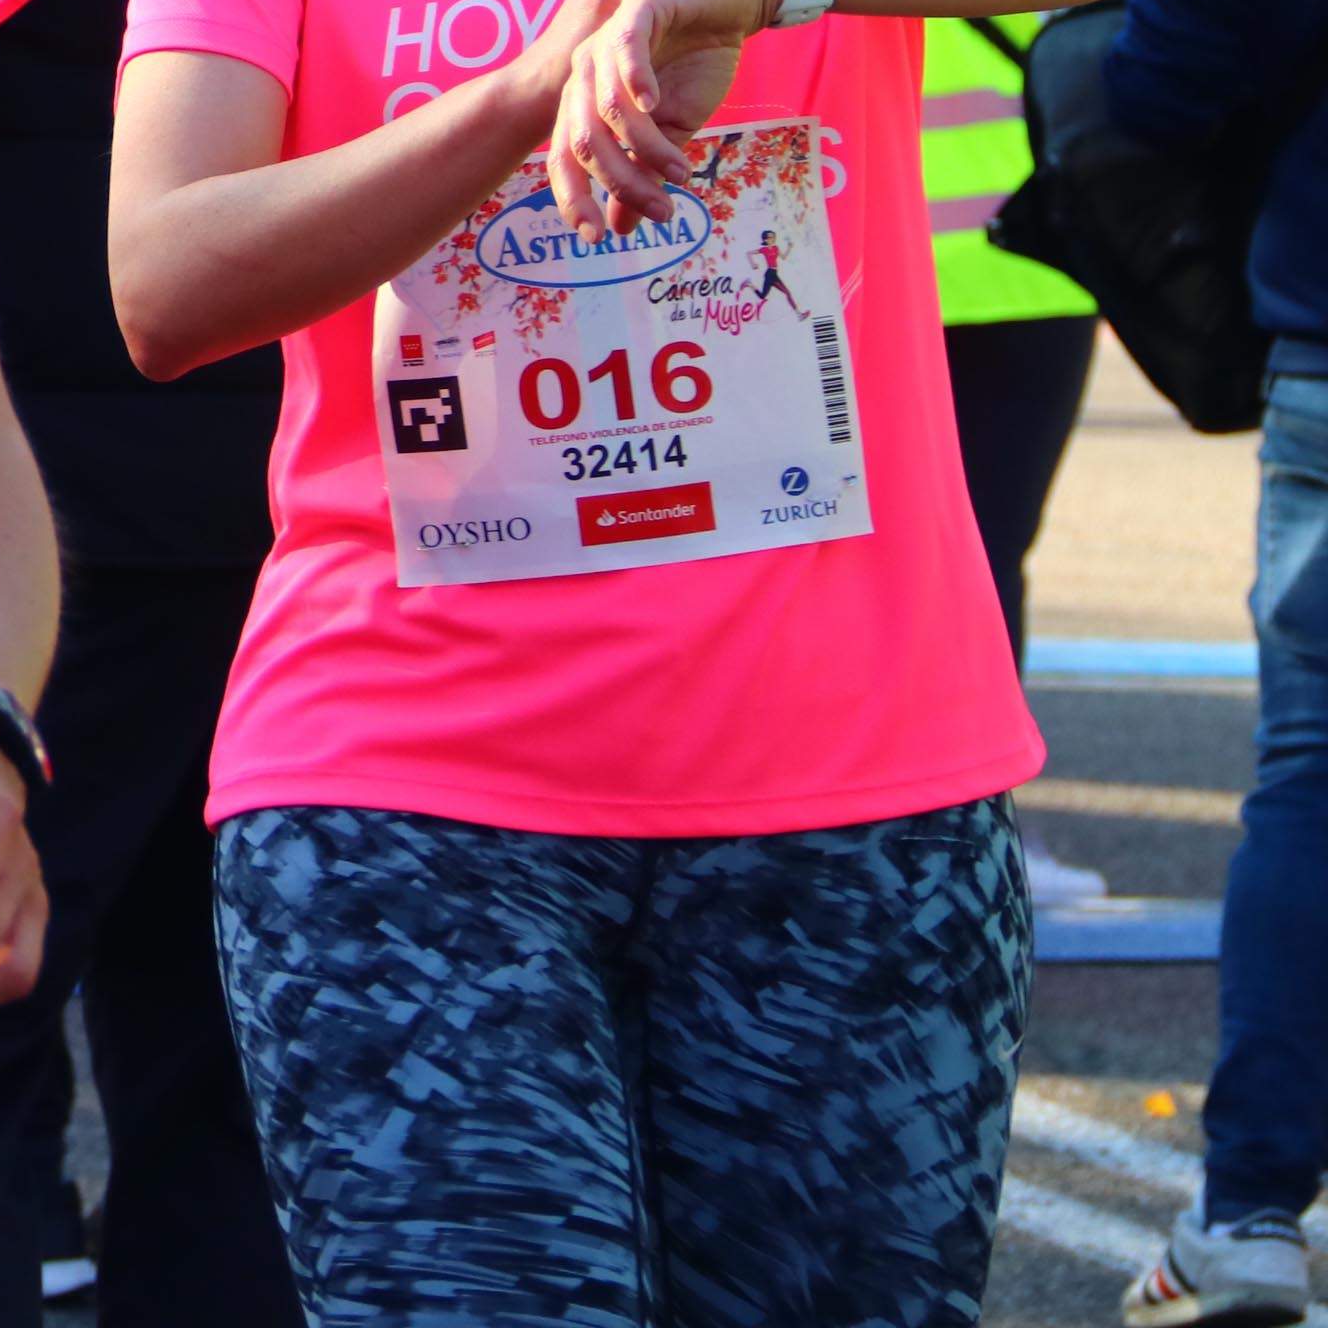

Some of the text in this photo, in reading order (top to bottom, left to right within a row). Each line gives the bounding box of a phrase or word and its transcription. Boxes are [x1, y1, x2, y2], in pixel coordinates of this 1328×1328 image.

[647, 274, 734, 304] Carrera
[670, 291, 768, 336] de la Mujer
[519, 341, 713, 430] 016
[652, 422, 667, 432] DE
[562, 434, 688, 481] 32414
[616, 502, 697, 526] Santander
[761, 499, 838, 525] ZURICH
[419, 517, 532, 549] OYSHO
